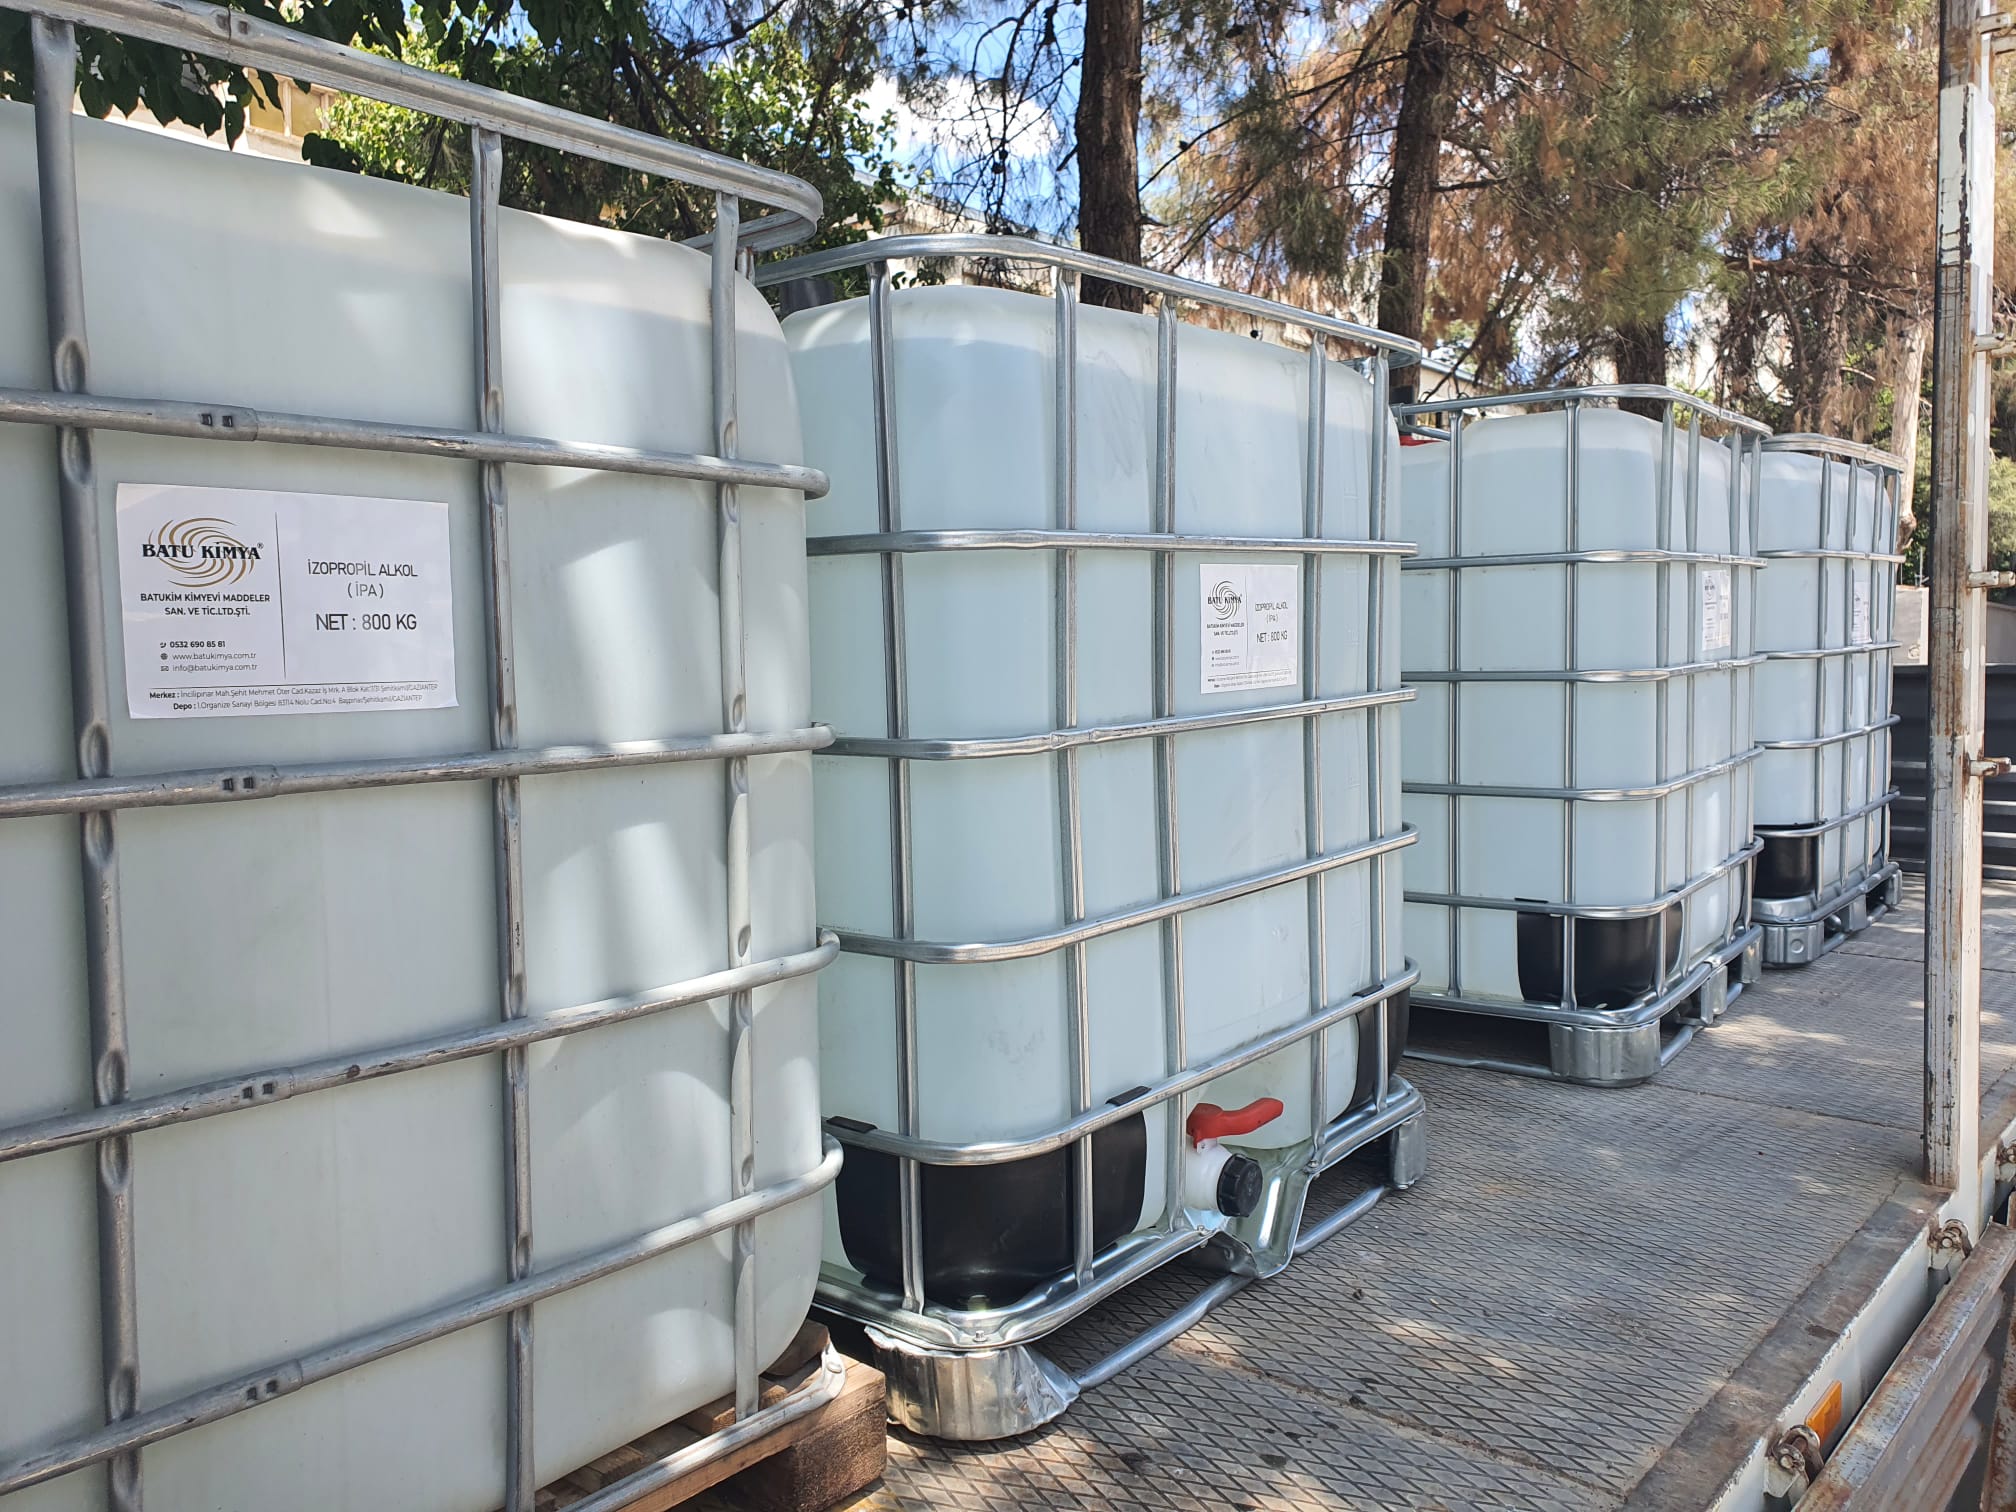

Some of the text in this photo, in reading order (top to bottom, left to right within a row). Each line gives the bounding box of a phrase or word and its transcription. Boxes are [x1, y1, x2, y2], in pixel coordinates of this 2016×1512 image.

[142, 544, 194, 558] BATU
[307, 559, 418, 577] İZOPROPİL ALKOL
[140, 591, 270, 603] BATUKİM KİMYEVİ MADDELER
[165, 607, 186, 616] SAN.
[188, 607, 200, 616] VE
[316, 613, 348, 631] NET
[362, 613, 391, 631] 800
[396, 613, 417, 631] KG
[206, 640, 216, 648] 85
[217, 640, 226, 648] 81
[172, 652, 257, 660] www.batukimya.com.tr
[172, 663, 258, 673] info@batukimya.com.tr
[173, 702, 193, 711] Depo
